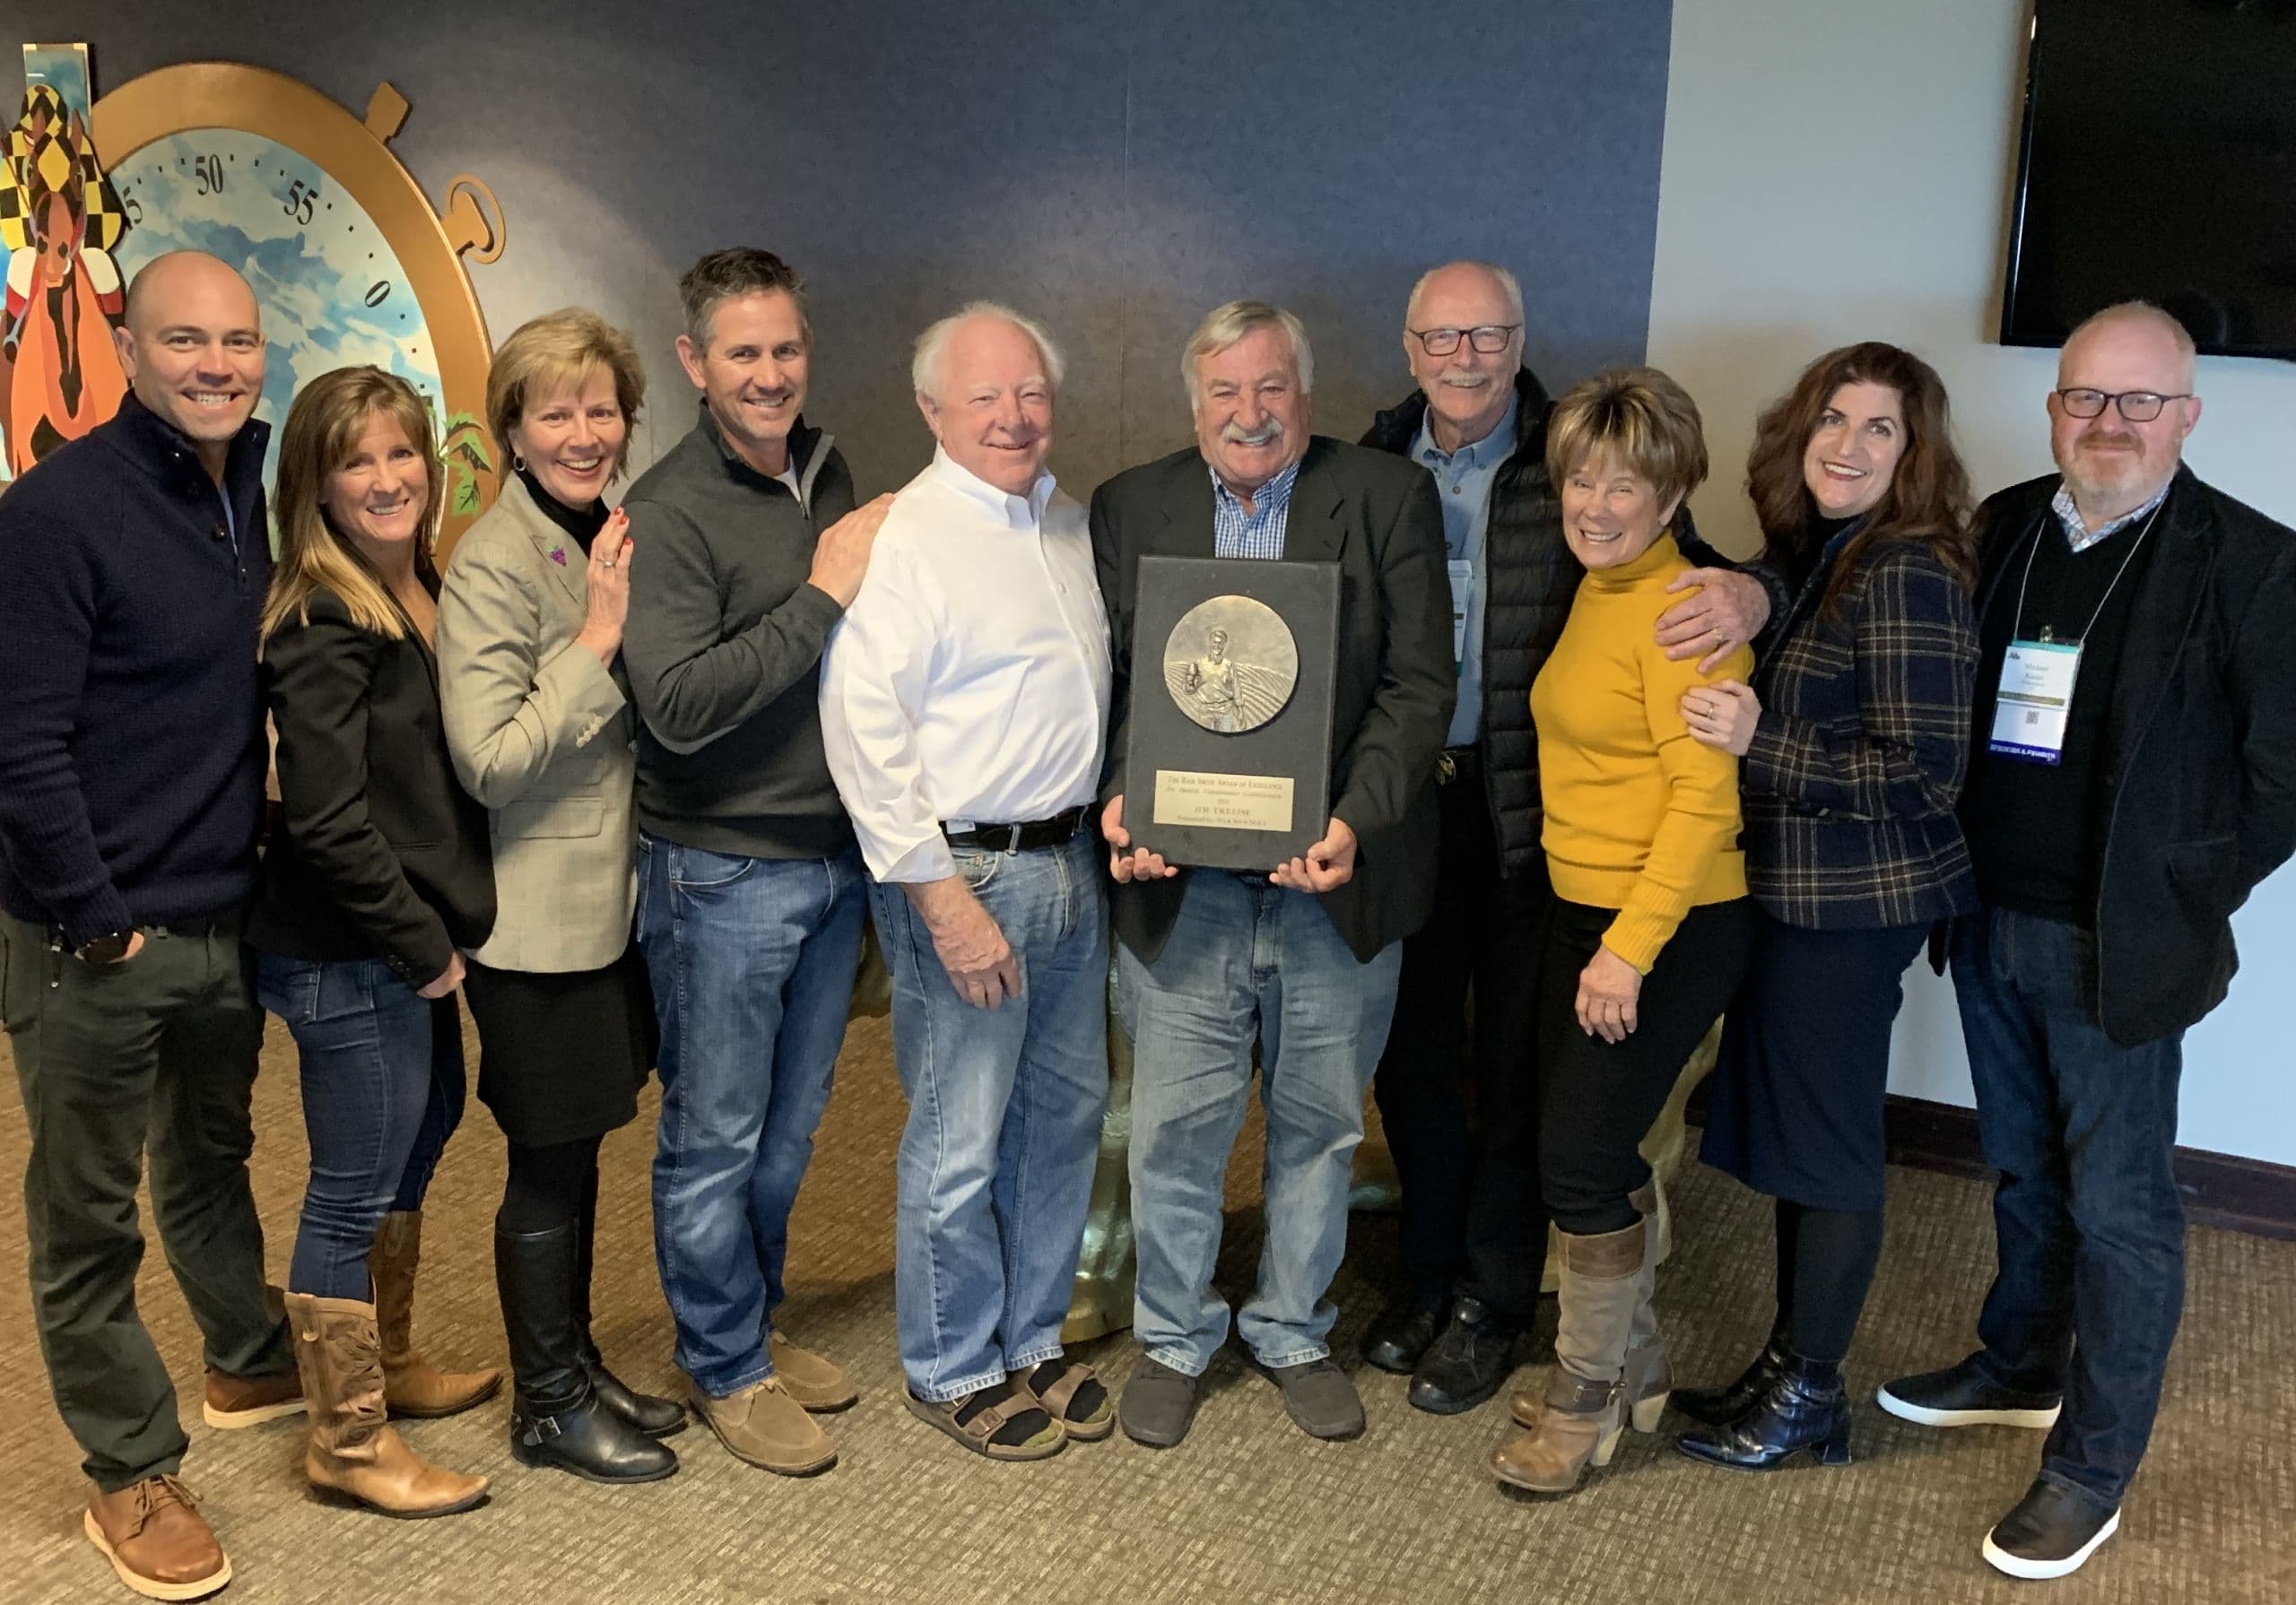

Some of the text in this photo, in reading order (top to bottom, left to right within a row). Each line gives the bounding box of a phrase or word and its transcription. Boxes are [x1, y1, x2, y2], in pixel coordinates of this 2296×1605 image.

[195, 154, 224, 195] 50
[123, 186, 144, 230] 5
[283, 179, 319, 225] 55
[364, 281, 391, 308] 0
